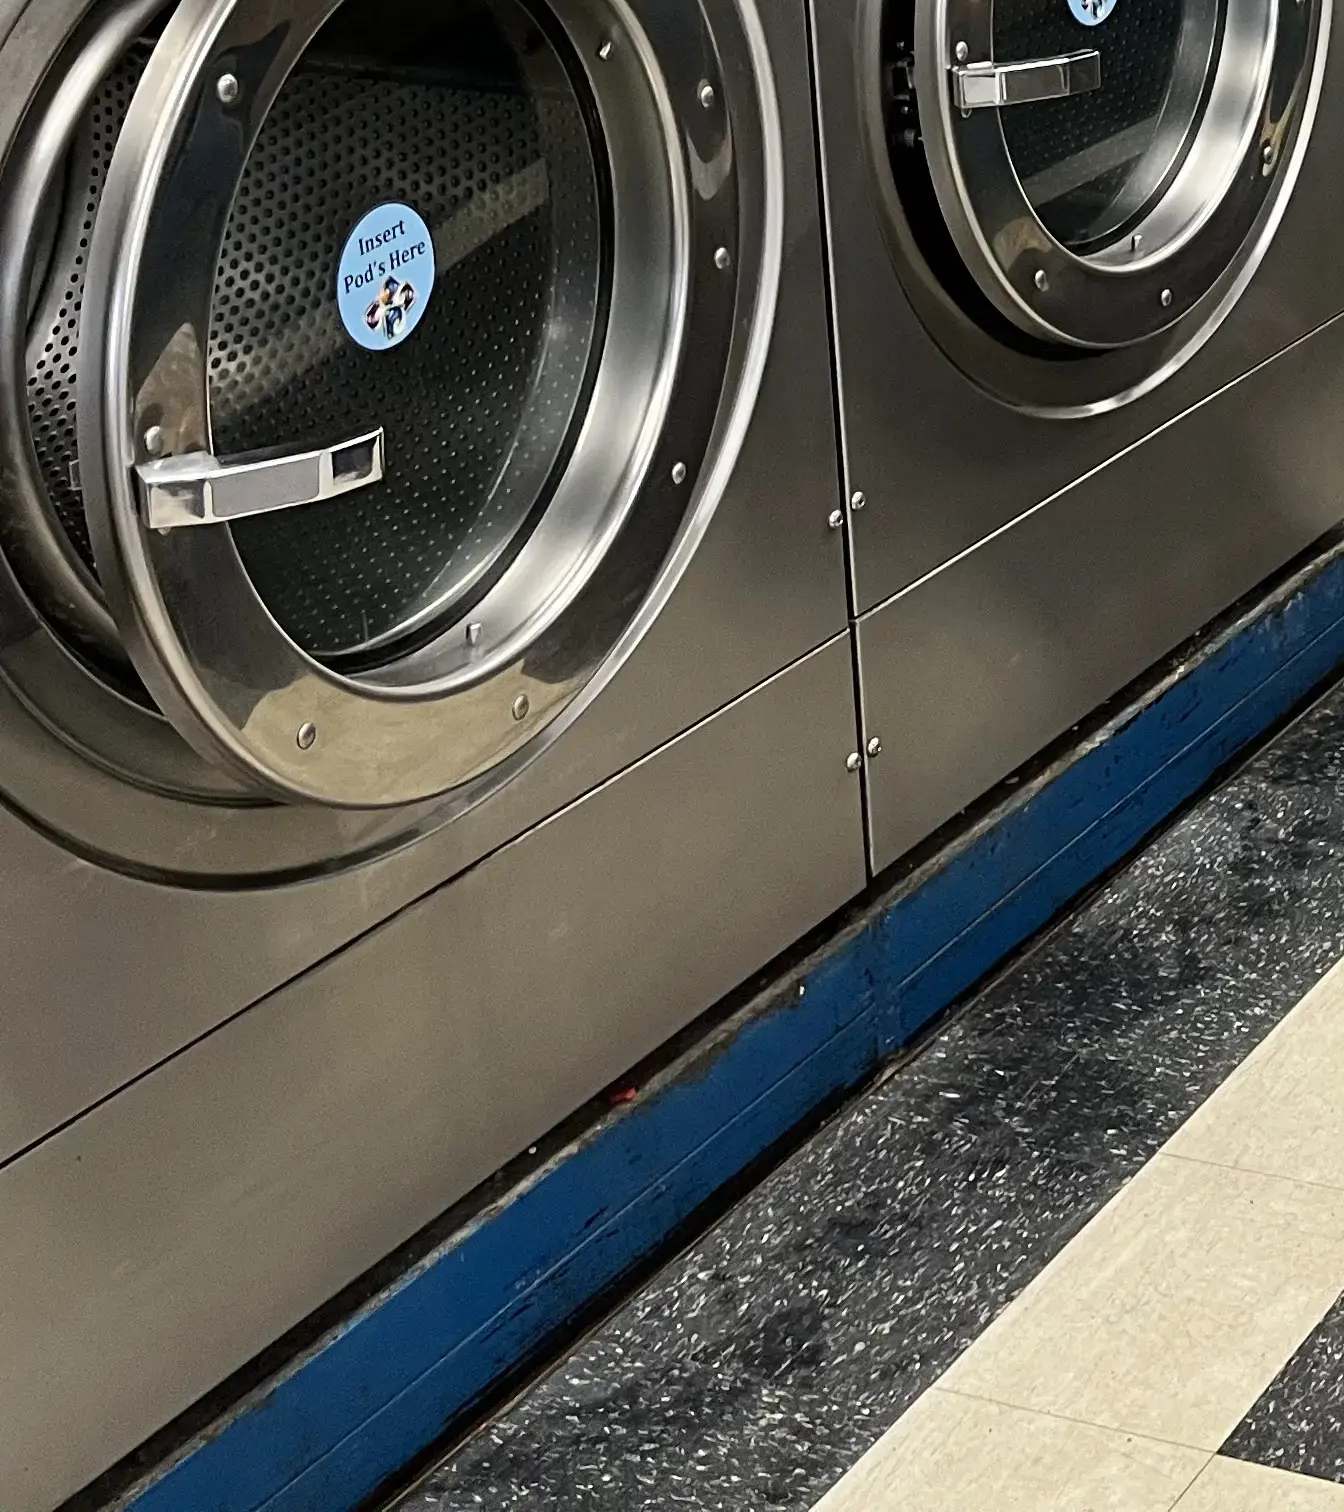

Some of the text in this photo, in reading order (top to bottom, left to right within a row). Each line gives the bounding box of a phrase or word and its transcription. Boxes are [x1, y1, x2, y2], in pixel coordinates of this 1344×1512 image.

[358, 219, 405, 257] Insert
[344, 241, 427, 294] Pod's Here
